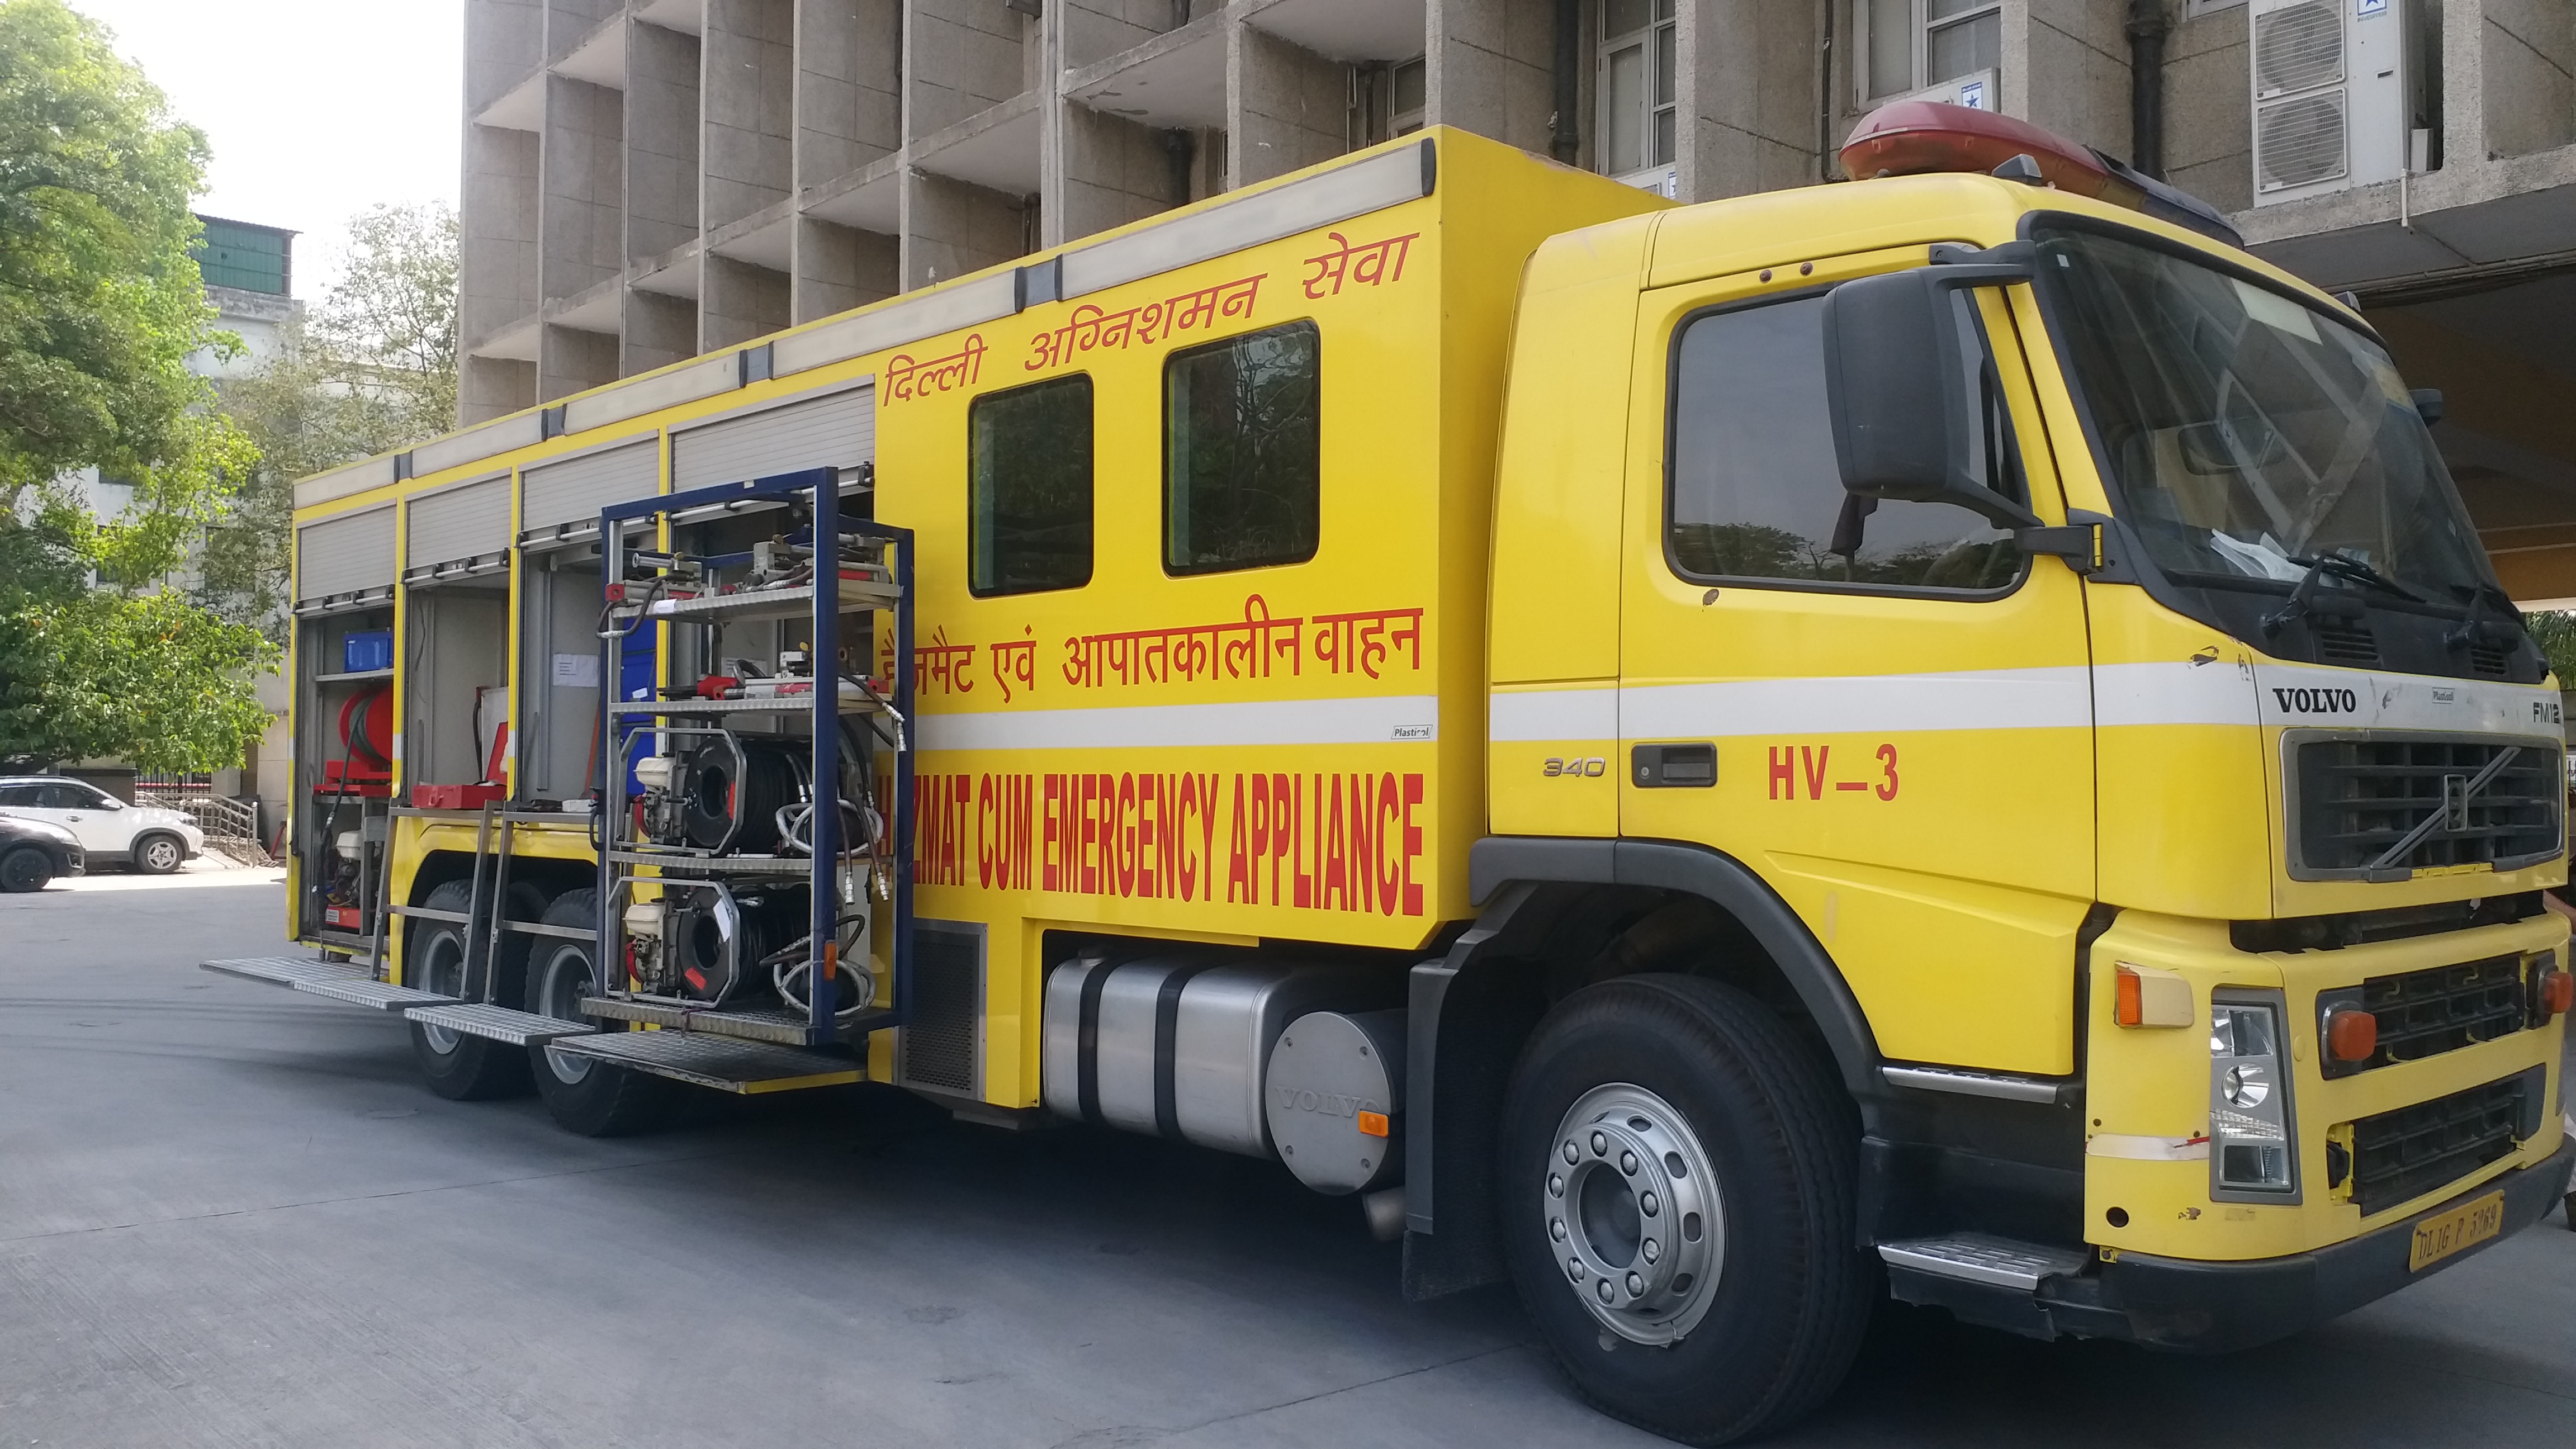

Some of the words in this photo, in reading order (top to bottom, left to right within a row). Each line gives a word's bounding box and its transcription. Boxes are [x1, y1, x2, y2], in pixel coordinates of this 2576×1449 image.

[883, 333, 988, 407] दिल्ली
[1024, 272, 1268, 372] अग्निशमन
[1303, 232, 1420, 300] सेवा
[989, 623, 1037, 704] एवं
[1062, 593, 1304, 688] आपातकालीन
[1312, 607, 1424, 680] वाहन
[2272, 688, 2356, 713] VOLVO
[2533, 702, 2560, 724] FM12
[1543, 757, 1606, 778] 340
[978, 772, 1034, 891] CUM
[1041, 771, 1219, 903] EMERGENCY
[1227, 771, 1424, 917] APPLIANCE
[2455, 1216, 2465, 1245] P
